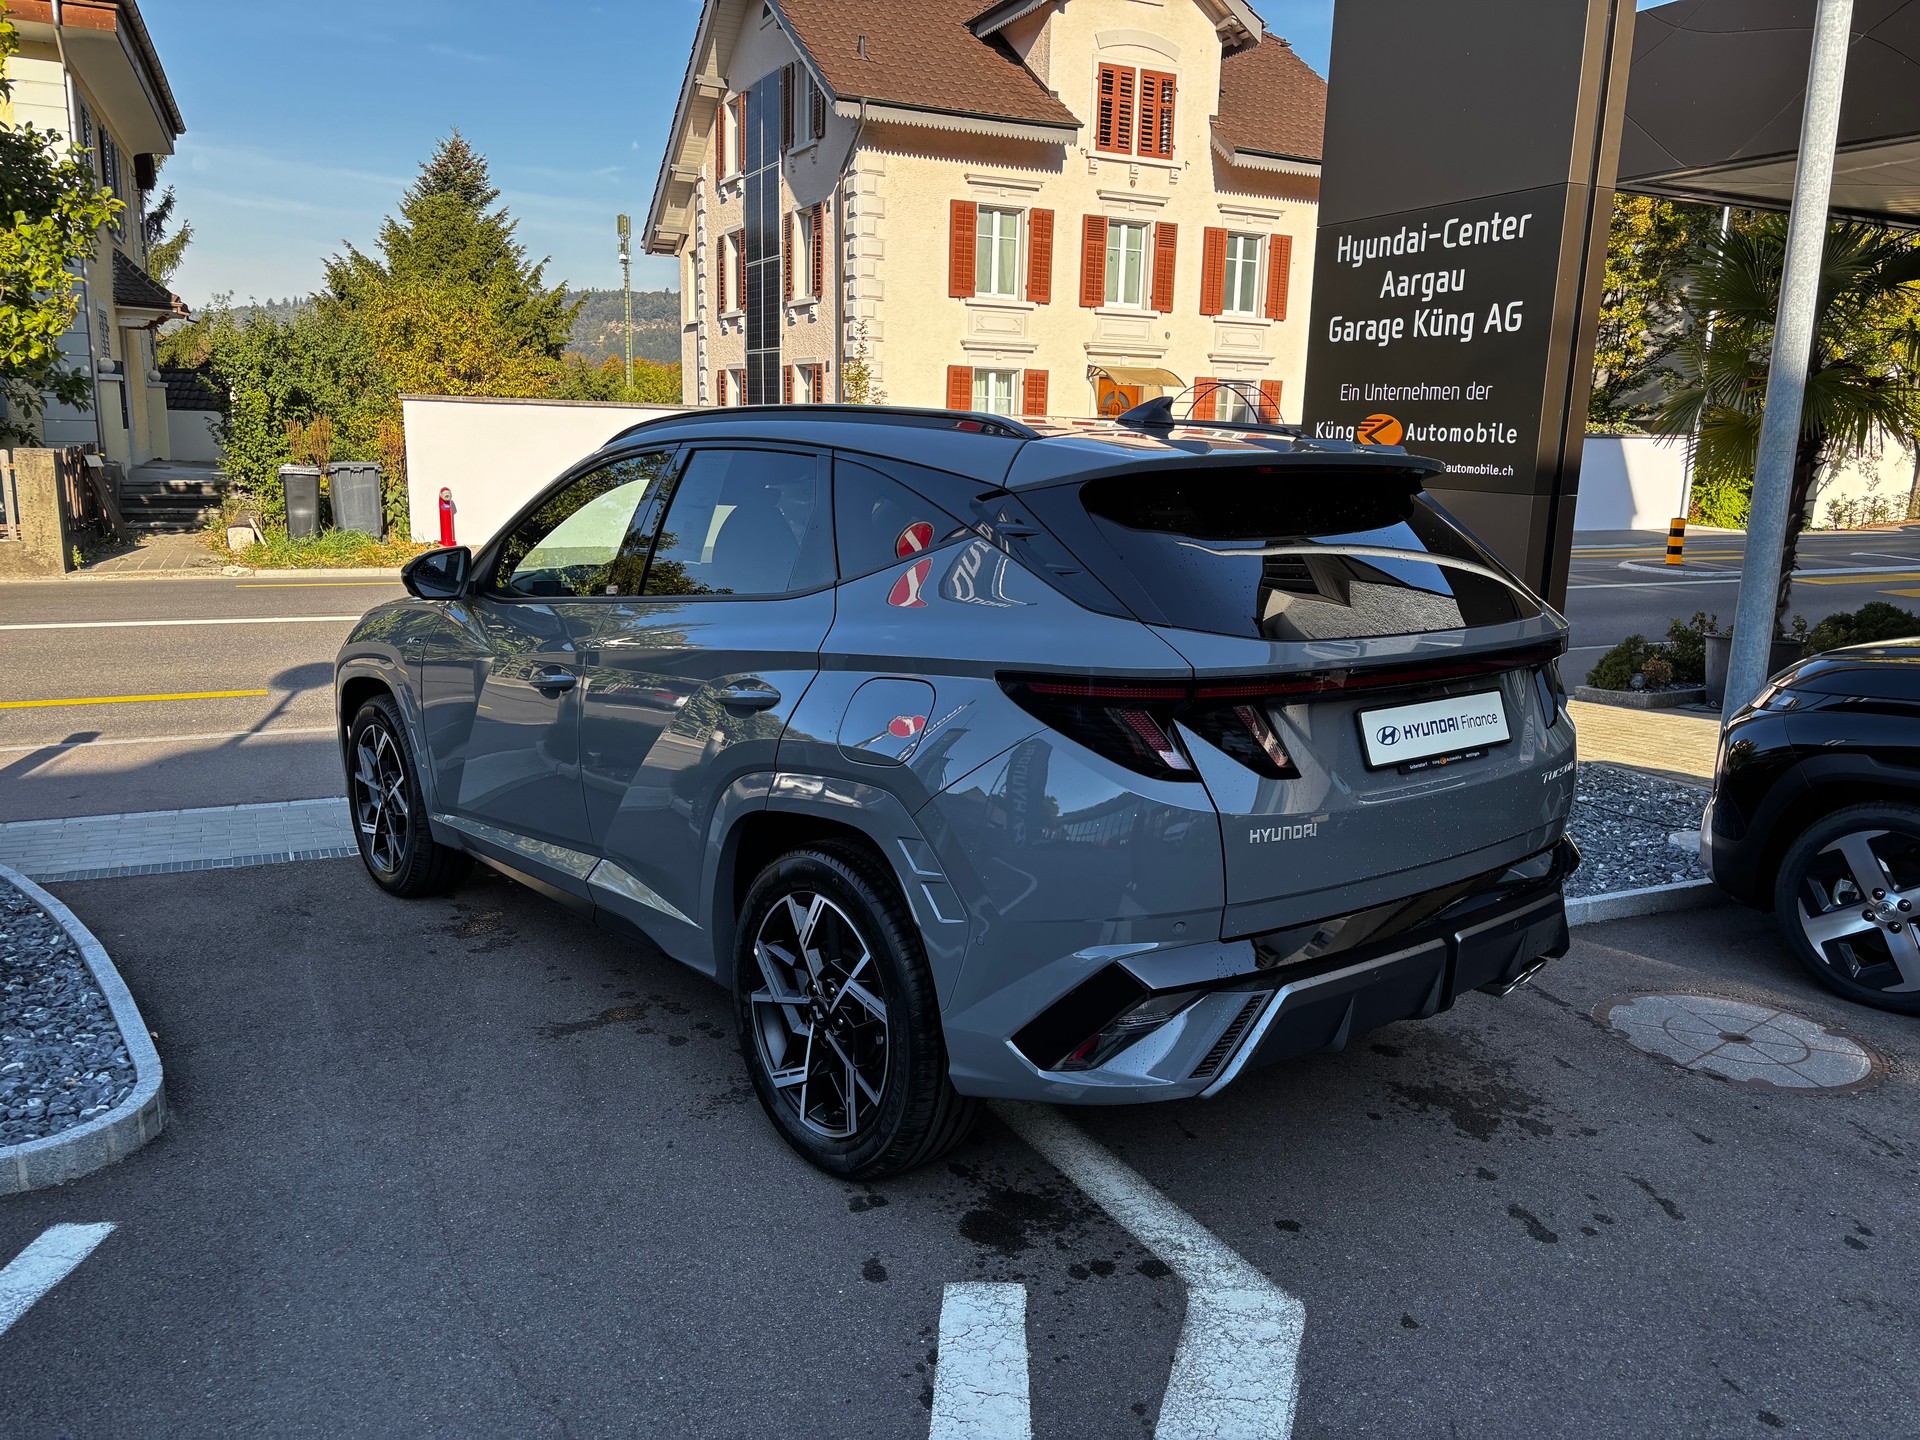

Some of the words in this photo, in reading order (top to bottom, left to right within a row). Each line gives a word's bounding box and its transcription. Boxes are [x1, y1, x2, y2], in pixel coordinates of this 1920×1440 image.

[1337, 212, 1533, 268] Hyundai-Center
[1379, 268, 1466, 302] Aargau
[1328, 315, 1404, 347] Garage
[1412, 308, 1475, 343] Küng
[1483, 301, 1524, 334] AG
[1340, 383, 1361, 402] Ein
[1364, 382, 1460, 402] Unternehmen
[1466, 381, 1493, 401] der
[1315, 421, 1355, 441] Küng
[1405, 422, 1518, 444] Automobile
[1443, 463, 1515, 477] -automobile.ch
[1403, 716, 1460, 741] HYUNDAI
[1461, 712, 1499, 732] Finance
[1249, 822, 1318, 844] HYUNDAI
